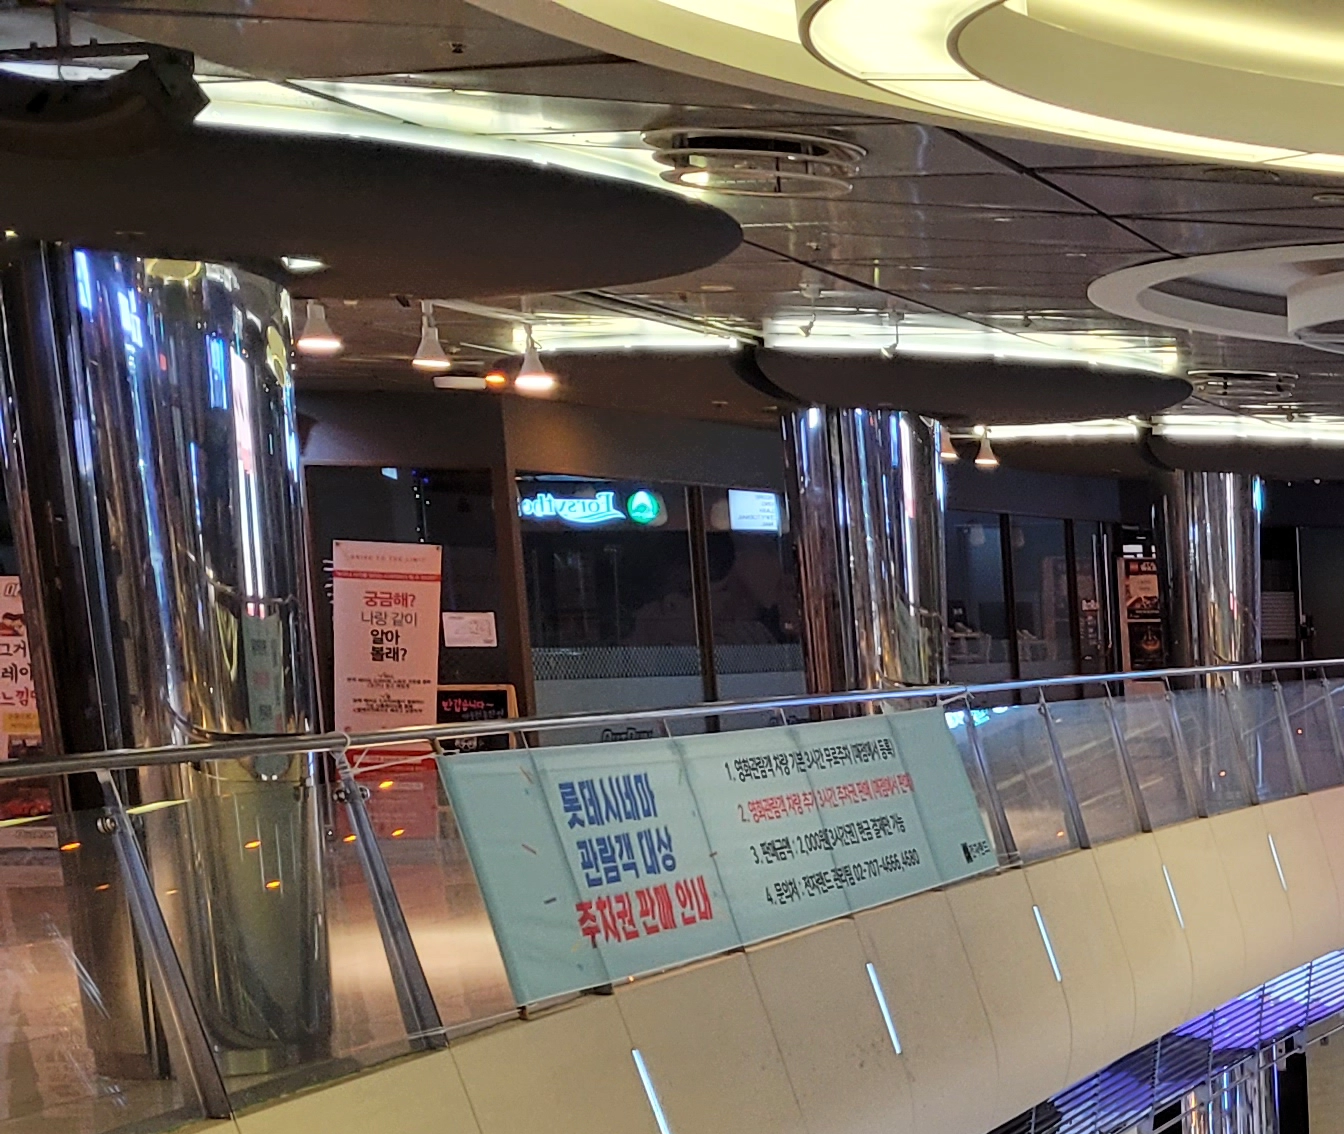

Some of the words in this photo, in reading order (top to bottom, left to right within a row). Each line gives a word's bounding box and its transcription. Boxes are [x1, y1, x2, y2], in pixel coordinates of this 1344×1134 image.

[363, 589, 416, 608] 궁금해?
[361, 611, 388, 627] 나랑
[391, 611, 418, 628] 같이
[370, 628, 401, 646] 알아
[370, 645, 408, 663] 볼래?
[725, 762, 736, 781] 1.
[734, 755, 775, 783] 영화관람객
[773, 753, 791, 776] 차량
[789, 751, 807, 773] 기본
[805, 747, 827, 770] 3시간
[823, 745, 853, 769] 무료주차
[558, 772, 659, 830] 롯데시네마
[738, 804, 750, 822] 2.
[786, 793, 803, 815] 차량
[816, 786, 839, 808] 3시간
[836, 783, 860, 806] 주차권
[576, 833, 640, 888] 관람객
[637, 825, 677, 876] 대상
[750, 845, 764, 864] 3.
[759, 836, 795, 865] 판매금액
[856, 819, 874, 842] 현금
[870, 815, 894, 839] 결제만
[889, 813, 906, 833] 가능
[765, 886, 778, 905] 4.
[774, 878, 801, 905] 문의처
[802, 871, 835, 897] 전자랜드
[831, 865, 856, 889] 관리팀
[575, 892, 640, 949] 주차권
[635, 883, 677, 935] 판매
[675, 875, 713, 926] 안내
